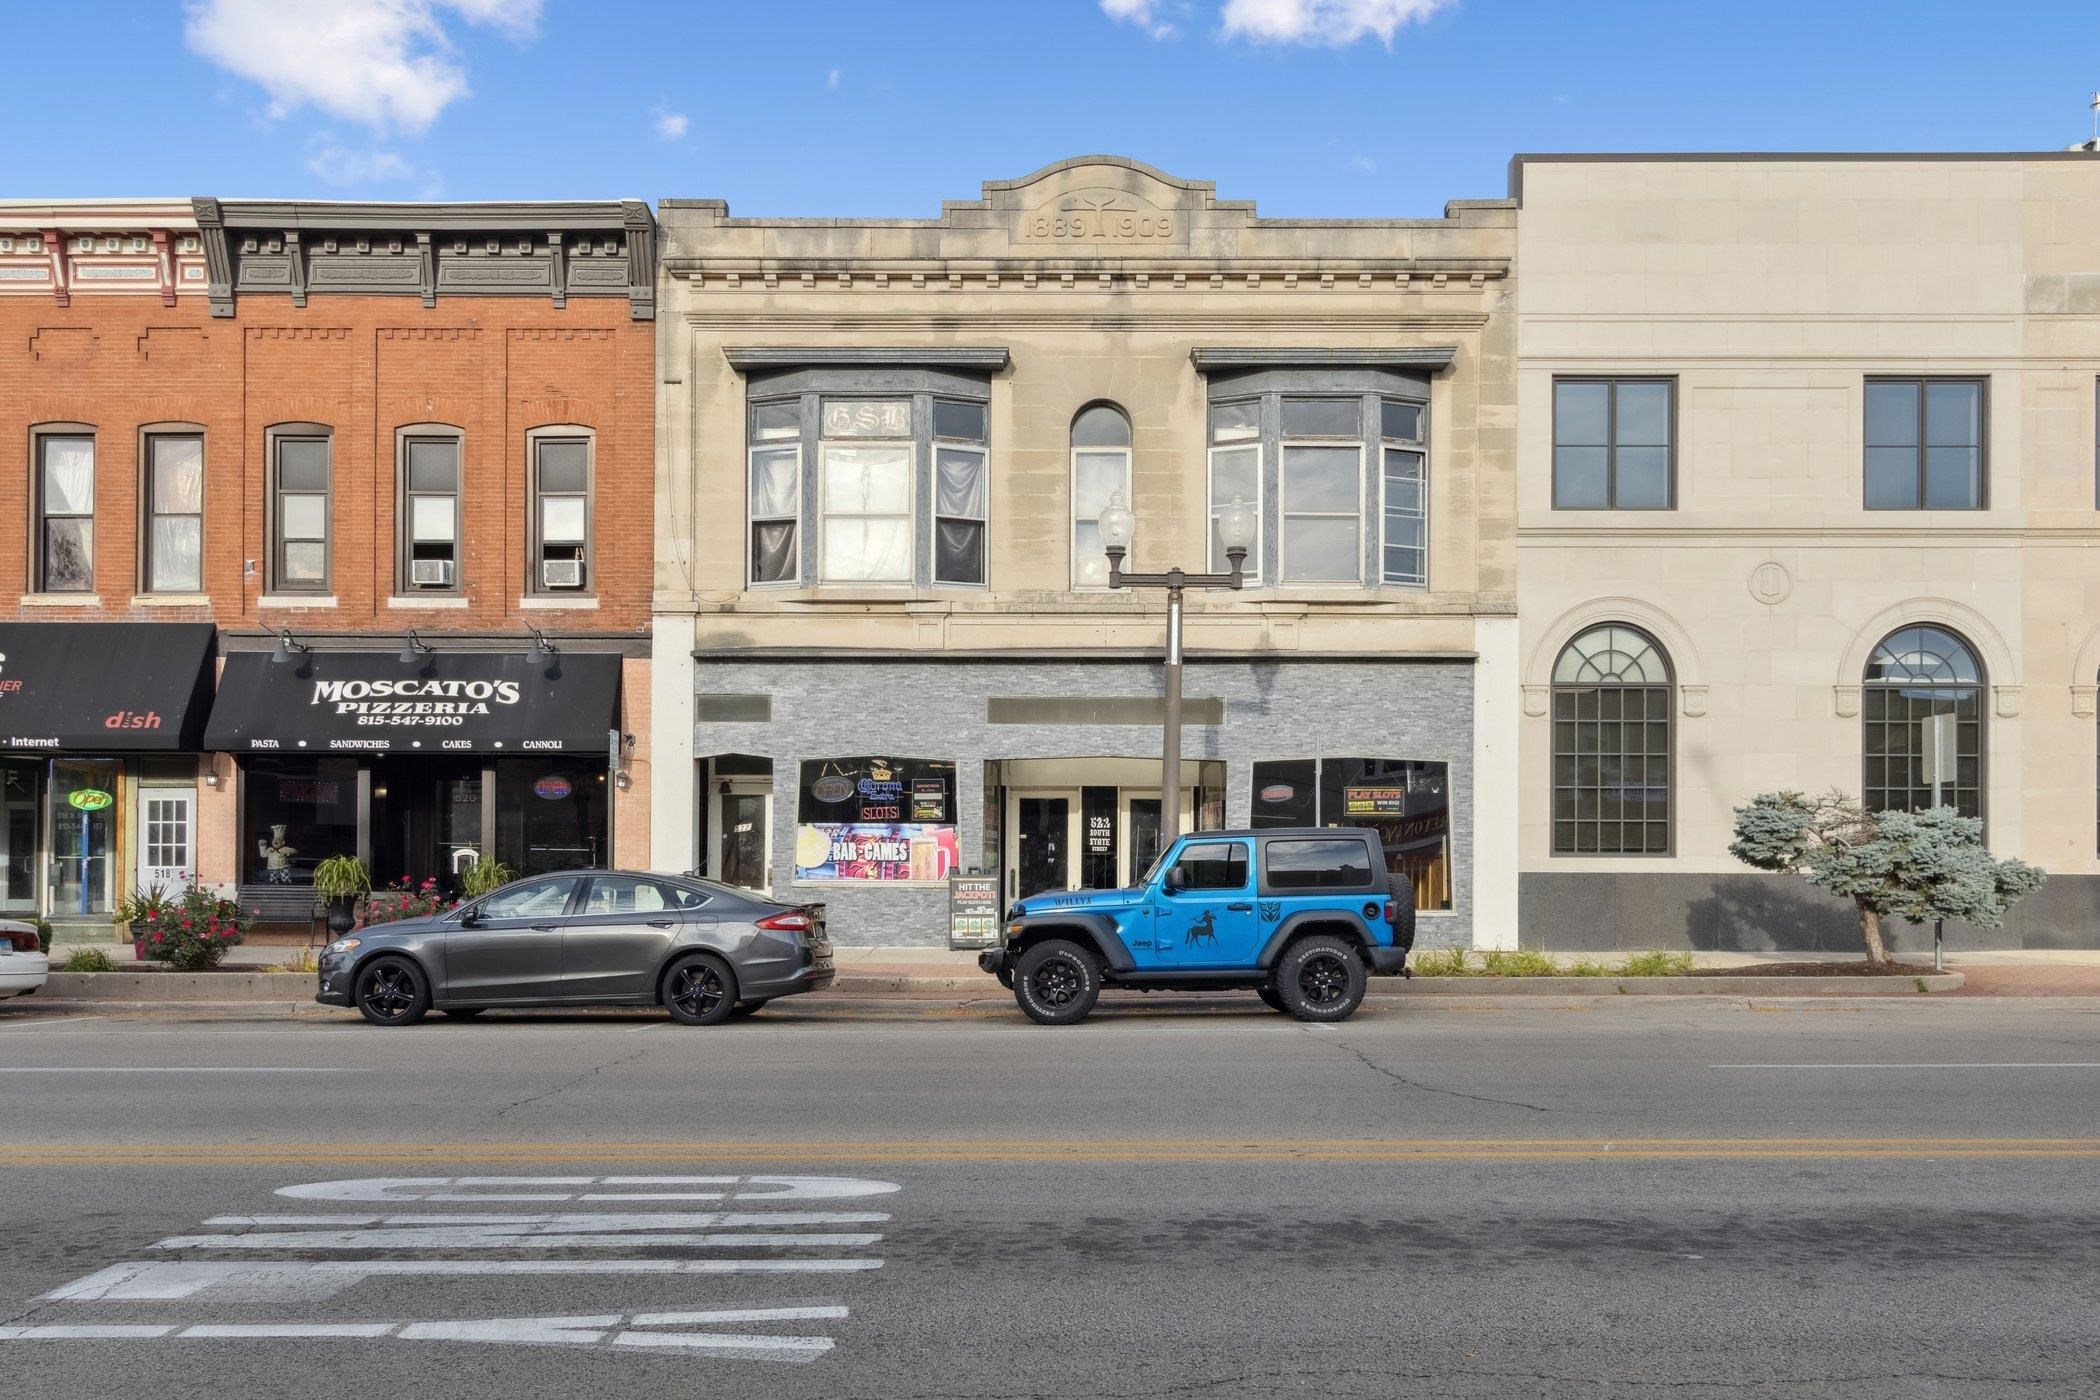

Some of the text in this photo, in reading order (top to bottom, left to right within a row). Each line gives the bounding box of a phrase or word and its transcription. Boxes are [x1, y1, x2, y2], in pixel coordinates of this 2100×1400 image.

[1025, 216, 1174, 238] 1889 1909
[311, 680, 520, 705] MOSCATO'S
[336, 702, 490, 714] PIZZERIA
[105, 711, 162, 729] dish
[357, 715, 463, 726] 815-547-9100
[11, 736, 60, 747] Internet
[251, 740, 279, 748] PASTA
[330, 740, 390, 749] SANDWICHES
[442, 740, 472, 749] CAKES
[523, 740, 562, 749] CANNOLI
[816, 782, 849, 797] OPEN
[857, 778, 903, 793] Corona
[1347, 790, 1401, 799] PLAY SLOTS
[863, 806, 898, 820] SLOTS
[1090, 816, 1111, 828] 522
[1089, 829, 1111, 837] SOUTH
[1089, 838, 1111, 846] STATE
[154, 868, 171, 879] 518
[958, 883, 991, 891] HIT THE
[1054, 895, 1093, 907] WILLYS
[1131, 939, 1153, 948] Jeep
